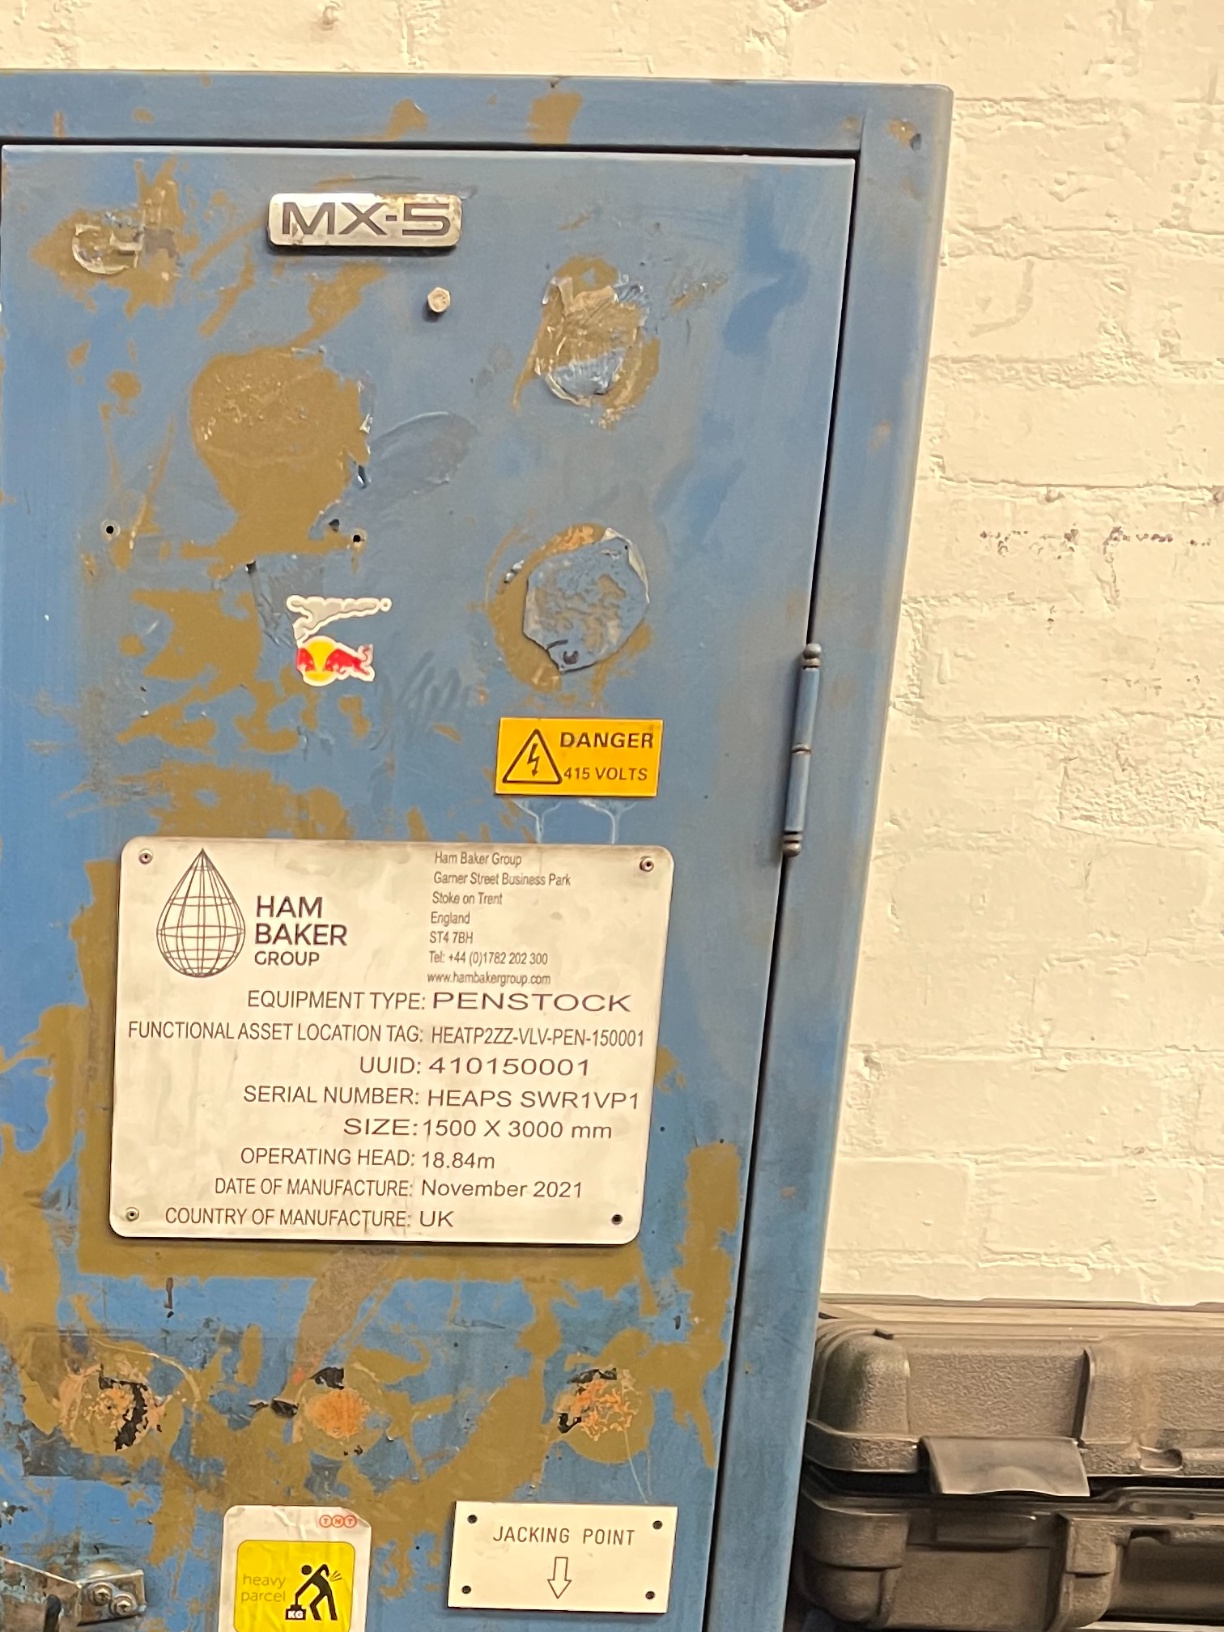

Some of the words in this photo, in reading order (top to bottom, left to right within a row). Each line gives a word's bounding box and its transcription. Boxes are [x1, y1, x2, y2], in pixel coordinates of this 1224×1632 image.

[281, 201, 452, 236] MX-5
[559, 731, 654, 749] DANGER
[563, 766, 590, 780] 415
[595, 766, 648, 782] VOLTS
[434, 851, 457, 865] Ham
[460, 851, 489, 866] Baker
[491, 852, 522, 868] Group
[470, 871, 499, 886] Street
[502, 872, 546, 886] Business
[548, 873, 571, 887] Park
[255, 895, 323, 919] HAM
[431, 891, 460, 905] Stoke
[462, 894, 475, 905] on
[478, 892, 503, 906] Trent
[431, 911, 471, 927] England
[254, 922, 348, 947] BAKER
[429, 931, 450, 944] ST4
[452, 931, 474, 945] 7BH
[253, 950, 321, 967] GROUP
[428, 950, 445, 964] Tel:
[448, 952, 466, 965] +44
[469, 951, 506, 967] (0)1782
[508, 952, 527, 965] 202
[529, 952, 548, 966] 300
[427, 971, 551, 987] www.hambakergroup.com
[247, 990, 365, 1009] EQUIPMENT
[369, 991, 426, 1011] TYPE:
[432, 991, 632, 1012] PENSTOCK
[128, 1020, 235, 1040] FUNCTIONAL
[237, 1022, 294, 1041] ASSET
[297, 1023, 383, 1042] LOCATION
[386, 1024, 424, 1043] TAG:
[431, 1025, 644, 1047] HEATP2ZZ-VLV-PEN-150001
[359, 1056, 421, 1075] UUID:
[428, 1057, 589, 1077] 410150001
[243, 1085, 317, 1103] SERIAL
[323, 1086, 419, 1105] NUMBER:
[427, 1089, 512, 1108] HEAPS
[519, 1090, 639, 1110] SWR1VP1
[343, 1117, 418, 1137] SIZE:
[423, 1118, 476, 1138] 1500
[483, 1120, 501, 1137] X
[507, 1120, 563, 1138] 3000
[571, 1125, 612, 1139] mm
[240, 1147, 351, 1165] OPERATING
[357, 1148, 415, 1167] HEAD:
[421, 1151, 495, 1169] 18.84m
[215, 1177, 256, 1195] DATE
[260, 1178, 282, 1195] OF
[287, 1178, 413, 1197] MANUFACTURE:
[421, 1179, 527, 1197] November
[532, 1181, 582, 1198] 2021
[165, 1207, 247, 1224] COUNTRY
[251, 1208, 275, 1225] OF
[279, 1209, 411, 1228] MANUFACTURE:
[419, 1210, 454, 1228] UK
[492, 1525, 570, 1544] JACKING
[582, 1528, 635, 1546] POINT
[242, 1573, 287, 1589] heavy
[241, 1590, 286, 1603] parcel
[287, 1610, 304, 1619] KG
